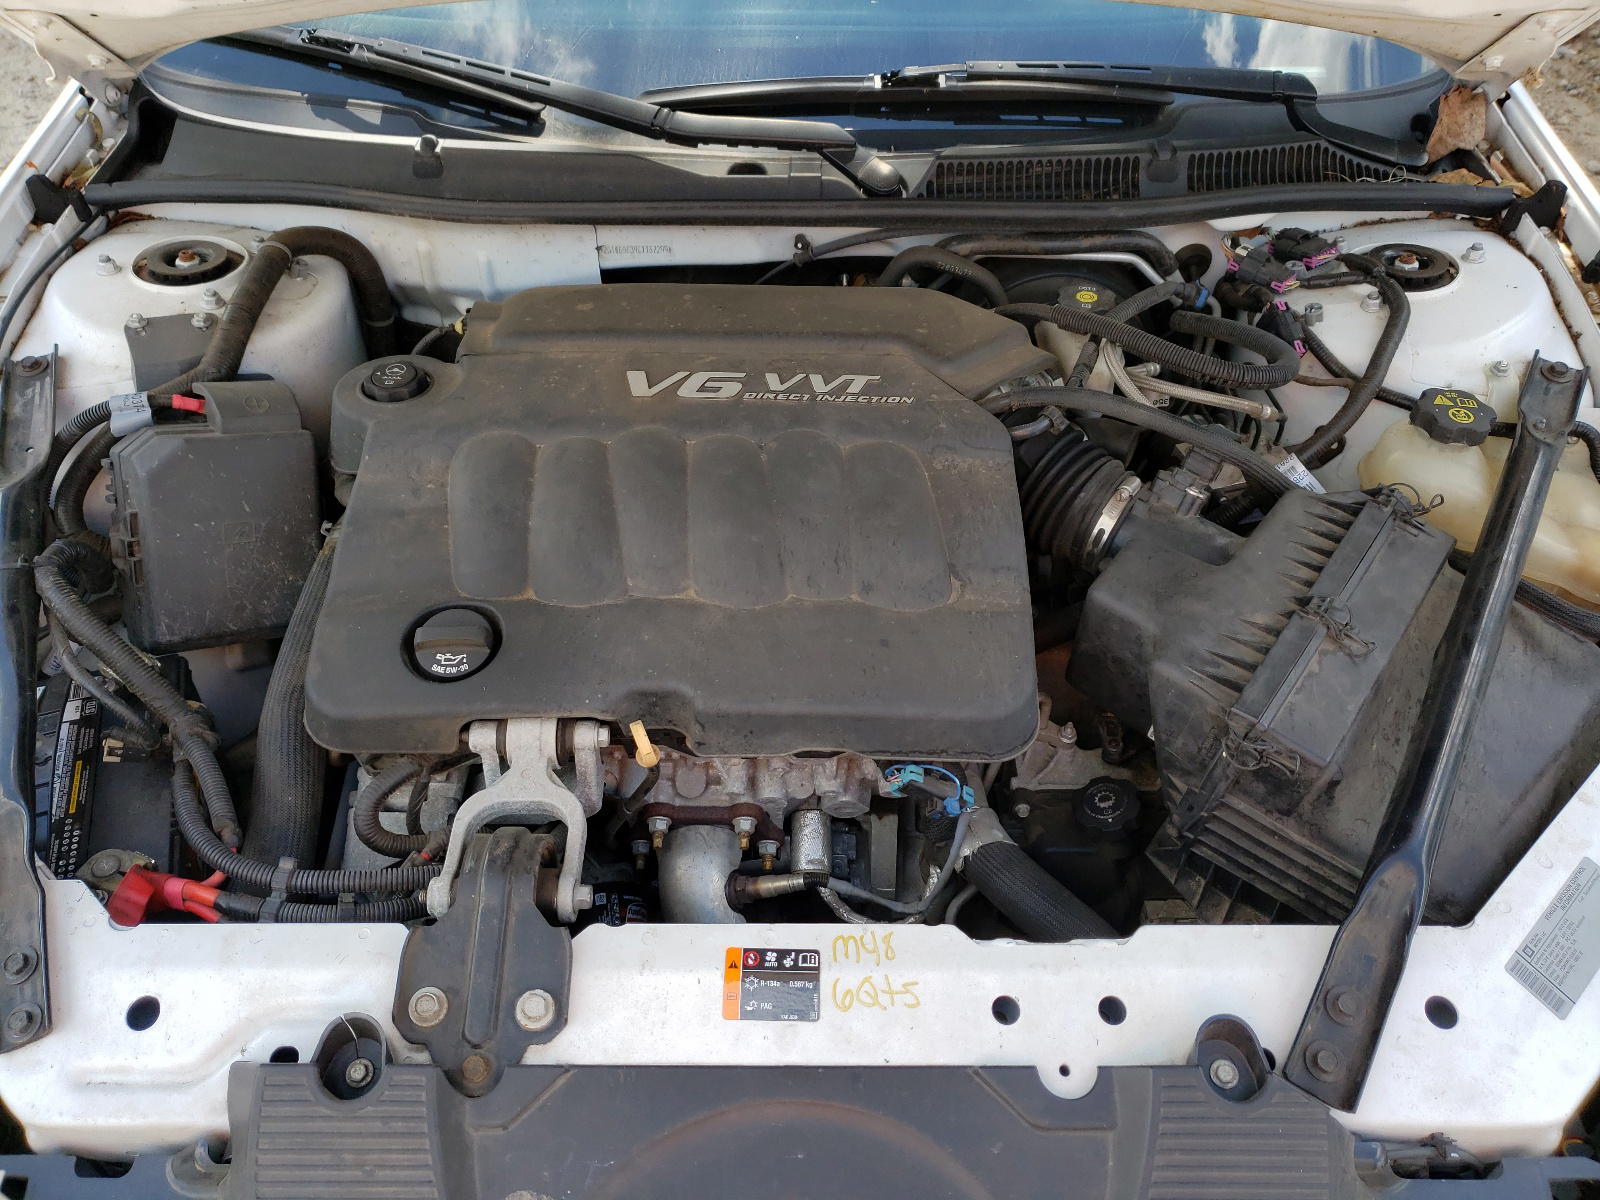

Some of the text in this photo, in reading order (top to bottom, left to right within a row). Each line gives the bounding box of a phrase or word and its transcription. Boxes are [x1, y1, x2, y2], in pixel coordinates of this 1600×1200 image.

[626, 370, 881, 400] V6 VVT
[743, 392, 915, 404] DIRECT INJECTION
[431, 664, 446, 674] SAE
[805, 980, 813, 989] kg
[760, 1002, 773, 1010] PAG
